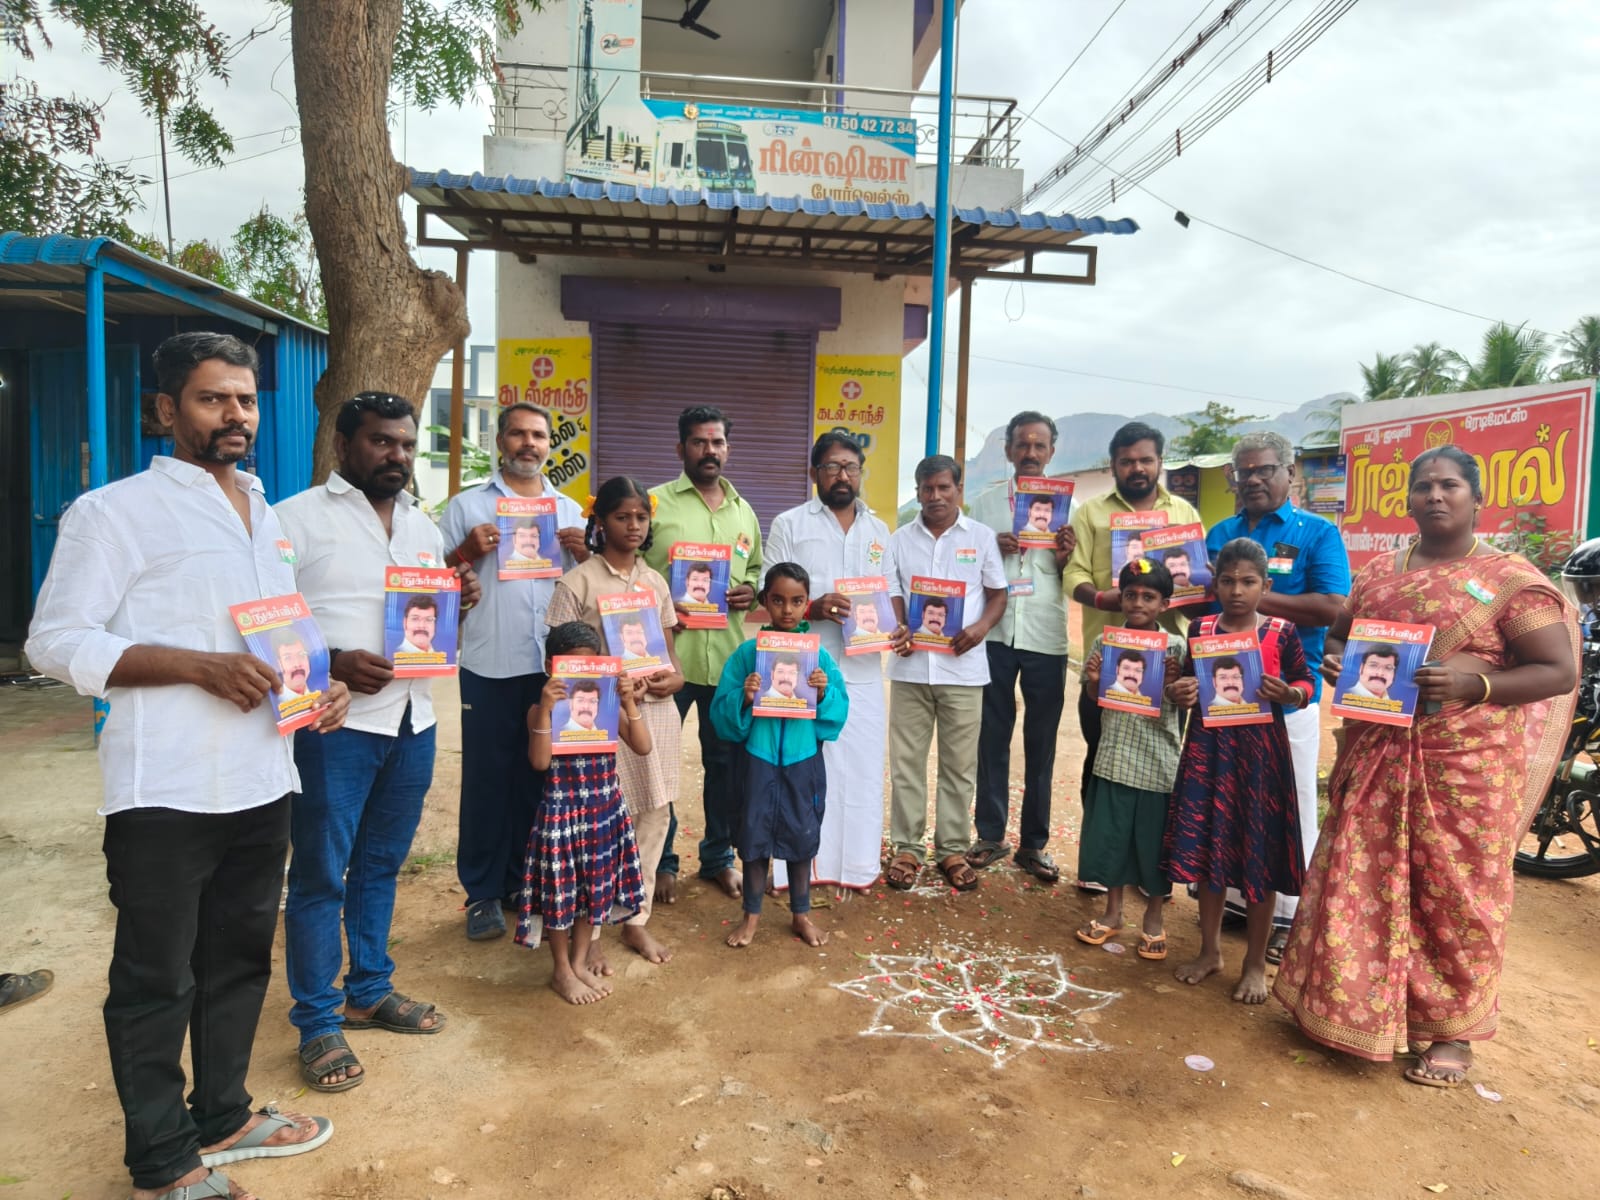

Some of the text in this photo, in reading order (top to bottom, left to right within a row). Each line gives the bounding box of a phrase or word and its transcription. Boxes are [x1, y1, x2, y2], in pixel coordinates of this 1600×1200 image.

[823, 115, 914, 135] 97 50 42 72 34
[759, 137, 911, 186] ரின்ஷிகா
